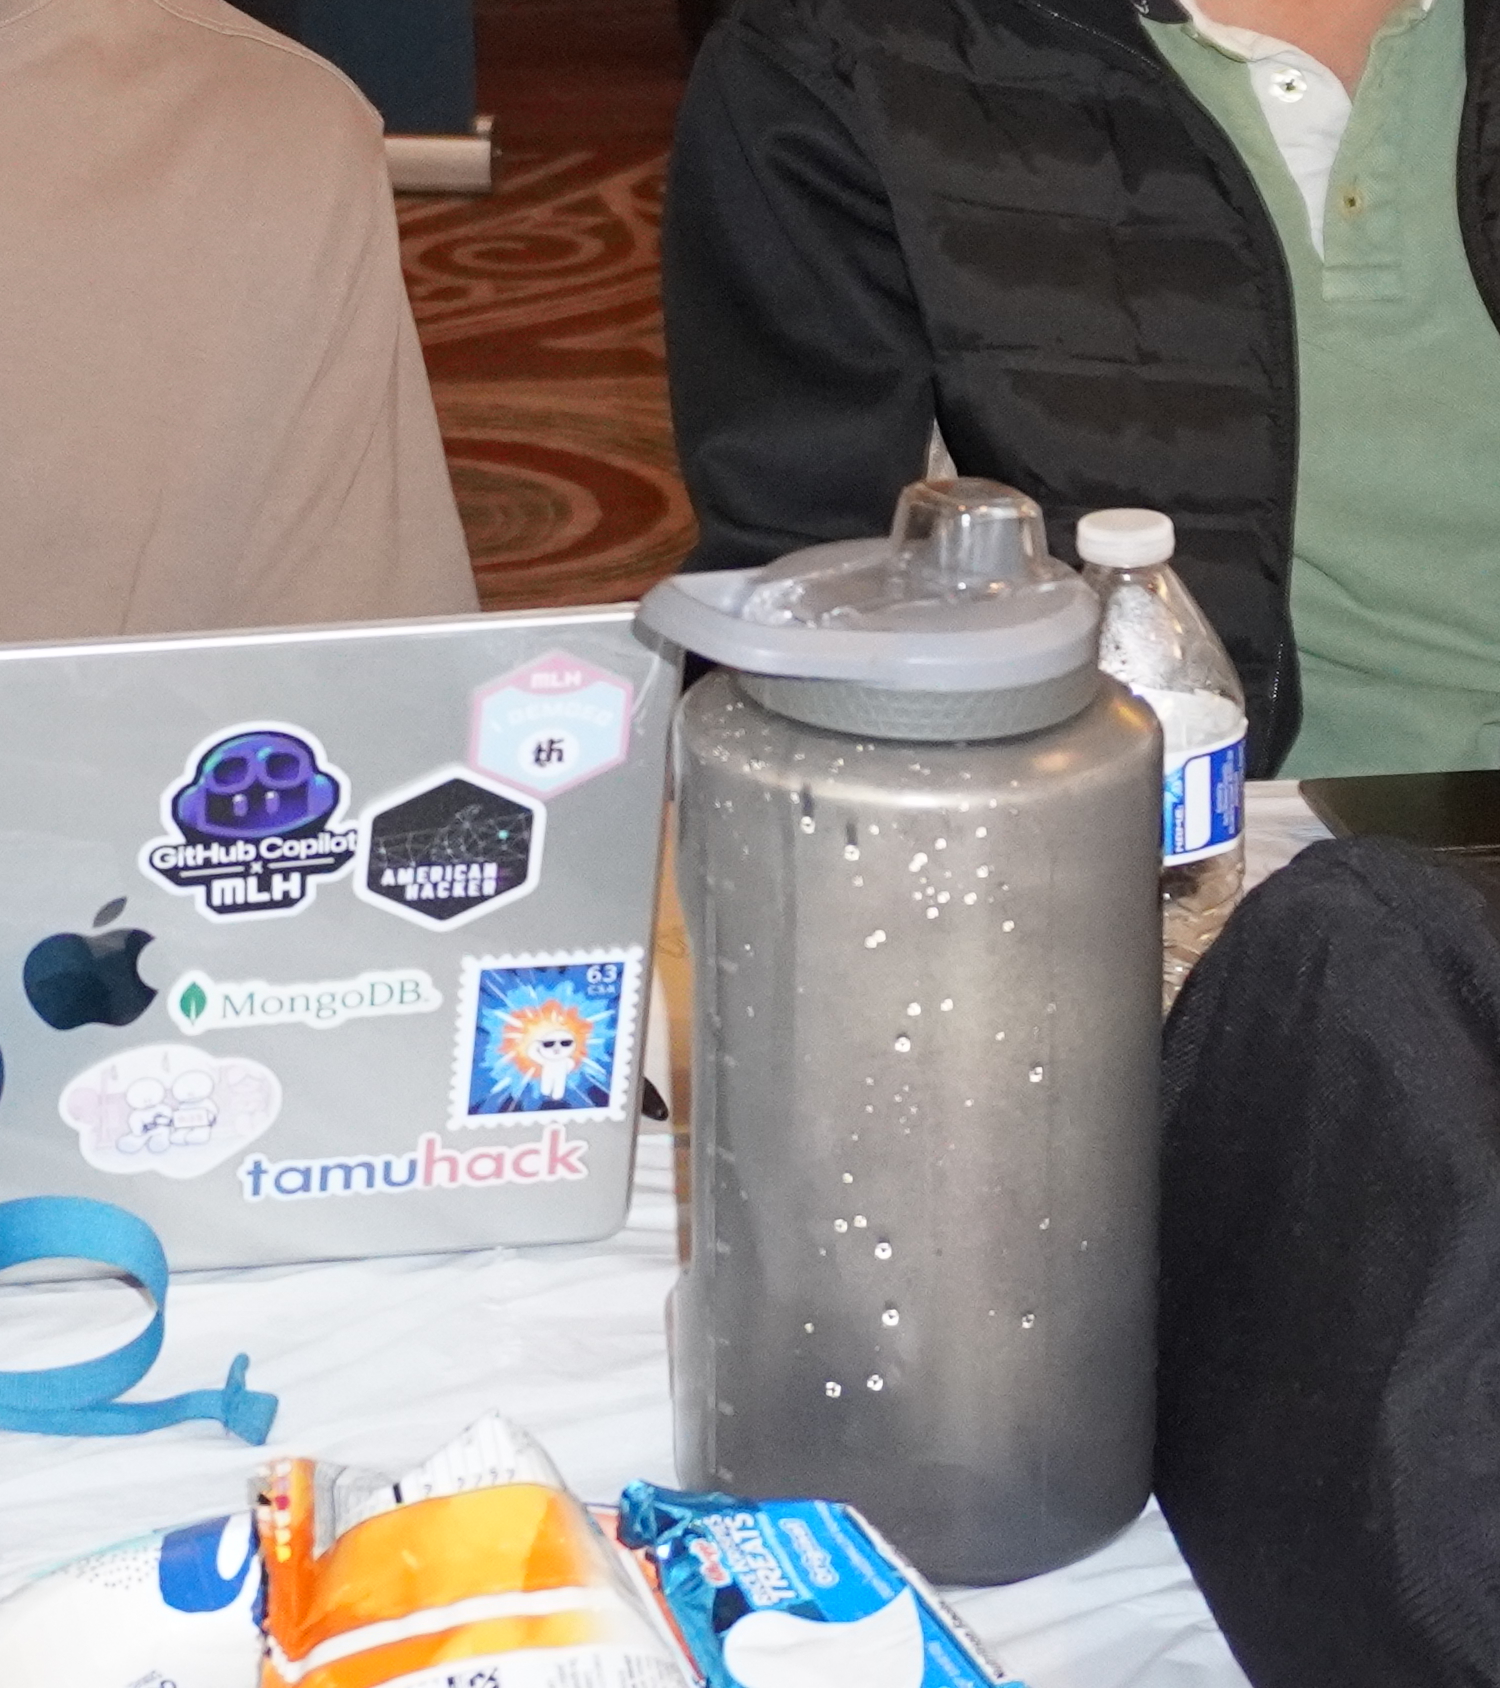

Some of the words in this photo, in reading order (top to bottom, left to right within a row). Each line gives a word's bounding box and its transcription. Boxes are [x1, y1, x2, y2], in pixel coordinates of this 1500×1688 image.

[530, 670, 583, 689] MLH
[151, 840, 258, 870] GitHub
[259, 830, 358, 859] Copilot
[211, 872, 301, 907] MLH
[380, 862, 499, 887] AMERICAN
[405, 878, 497, 901] HACKER
[586, 964, 617, 984] 63
[222, 979, 421, 1020] MongoDB
[246, 1129, 586, 1196] tamuhack
[728, 1513, 795, 1603] TREATS
